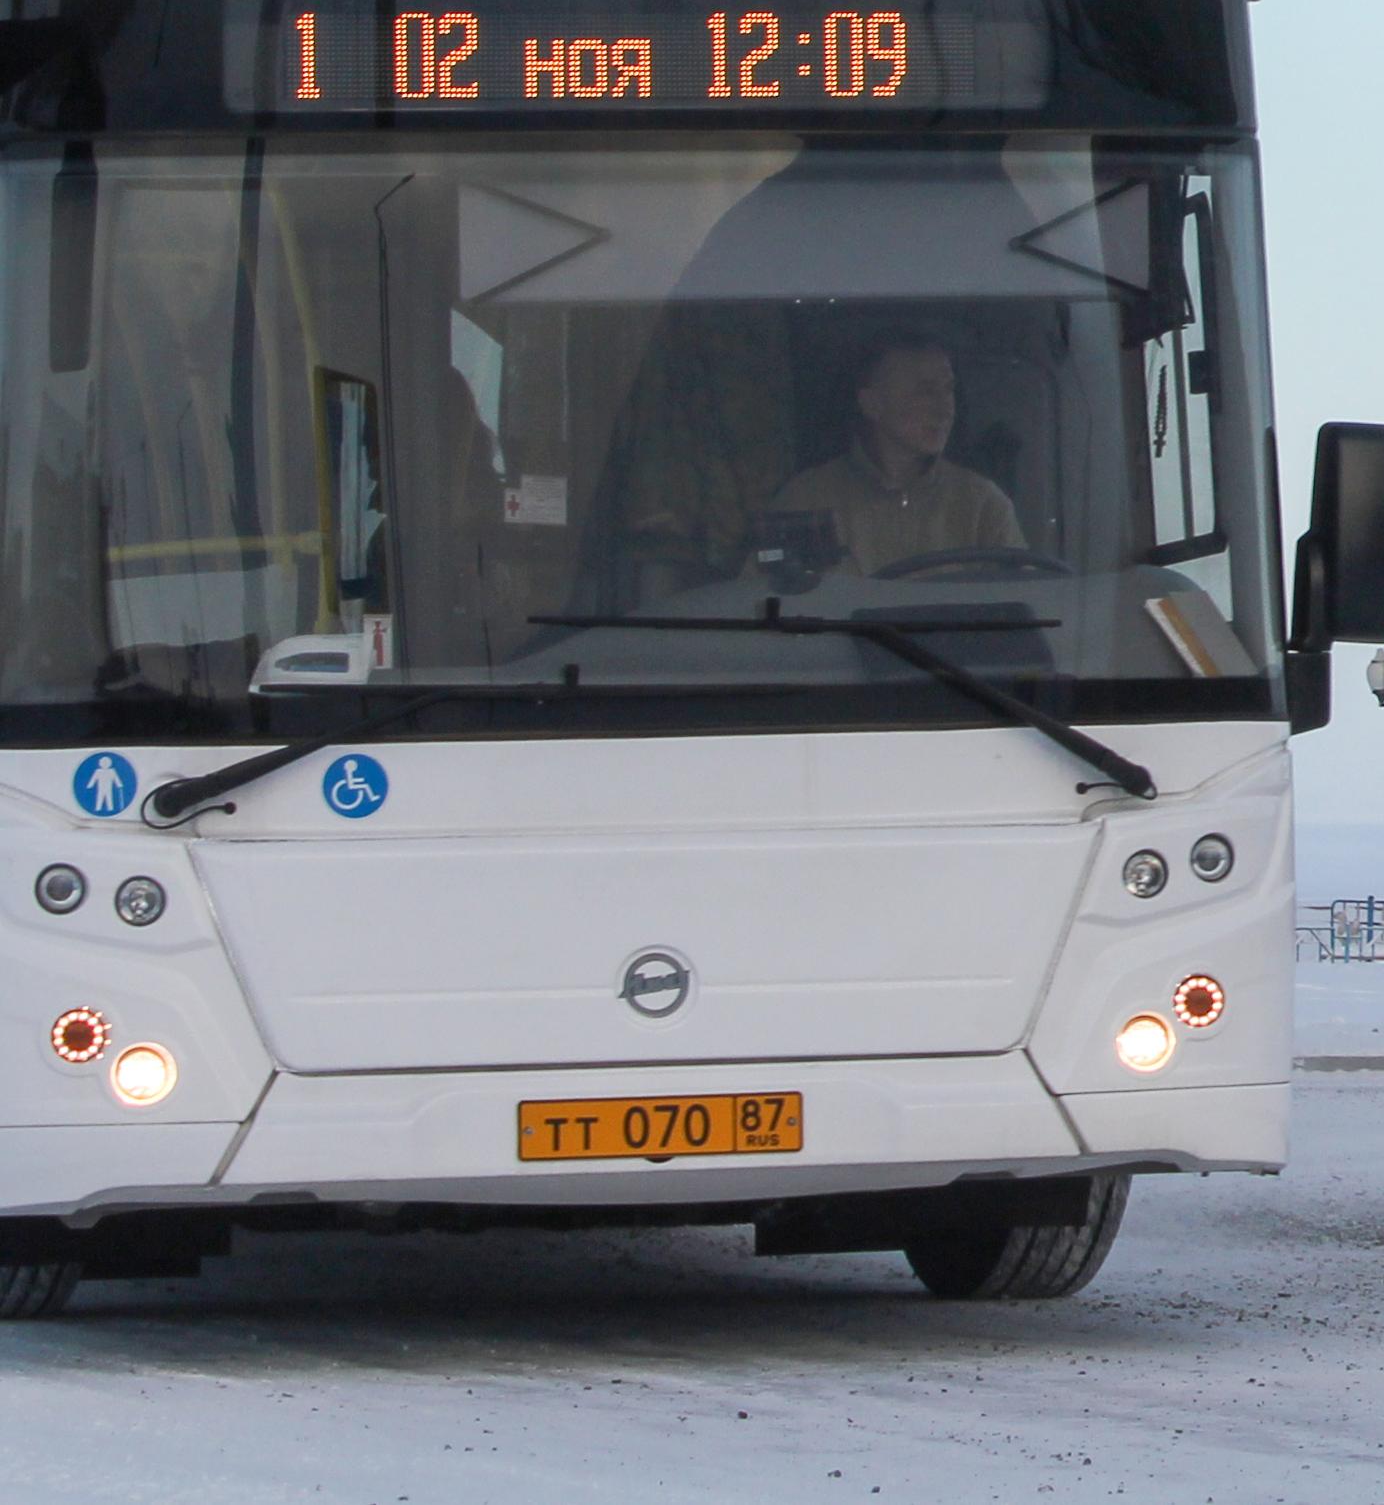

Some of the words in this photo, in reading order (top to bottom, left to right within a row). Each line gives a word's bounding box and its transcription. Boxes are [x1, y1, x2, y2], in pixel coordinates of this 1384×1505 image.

[294, 11, 322, 100] 1
[392, 10, 480, 100] 02
[704, 10, 908, 99] 12:09
[622, 1103, 712, 1150] 070
[740, 1097, 786, 1133] 87
[745, 1133, 781, 1147] RUS
